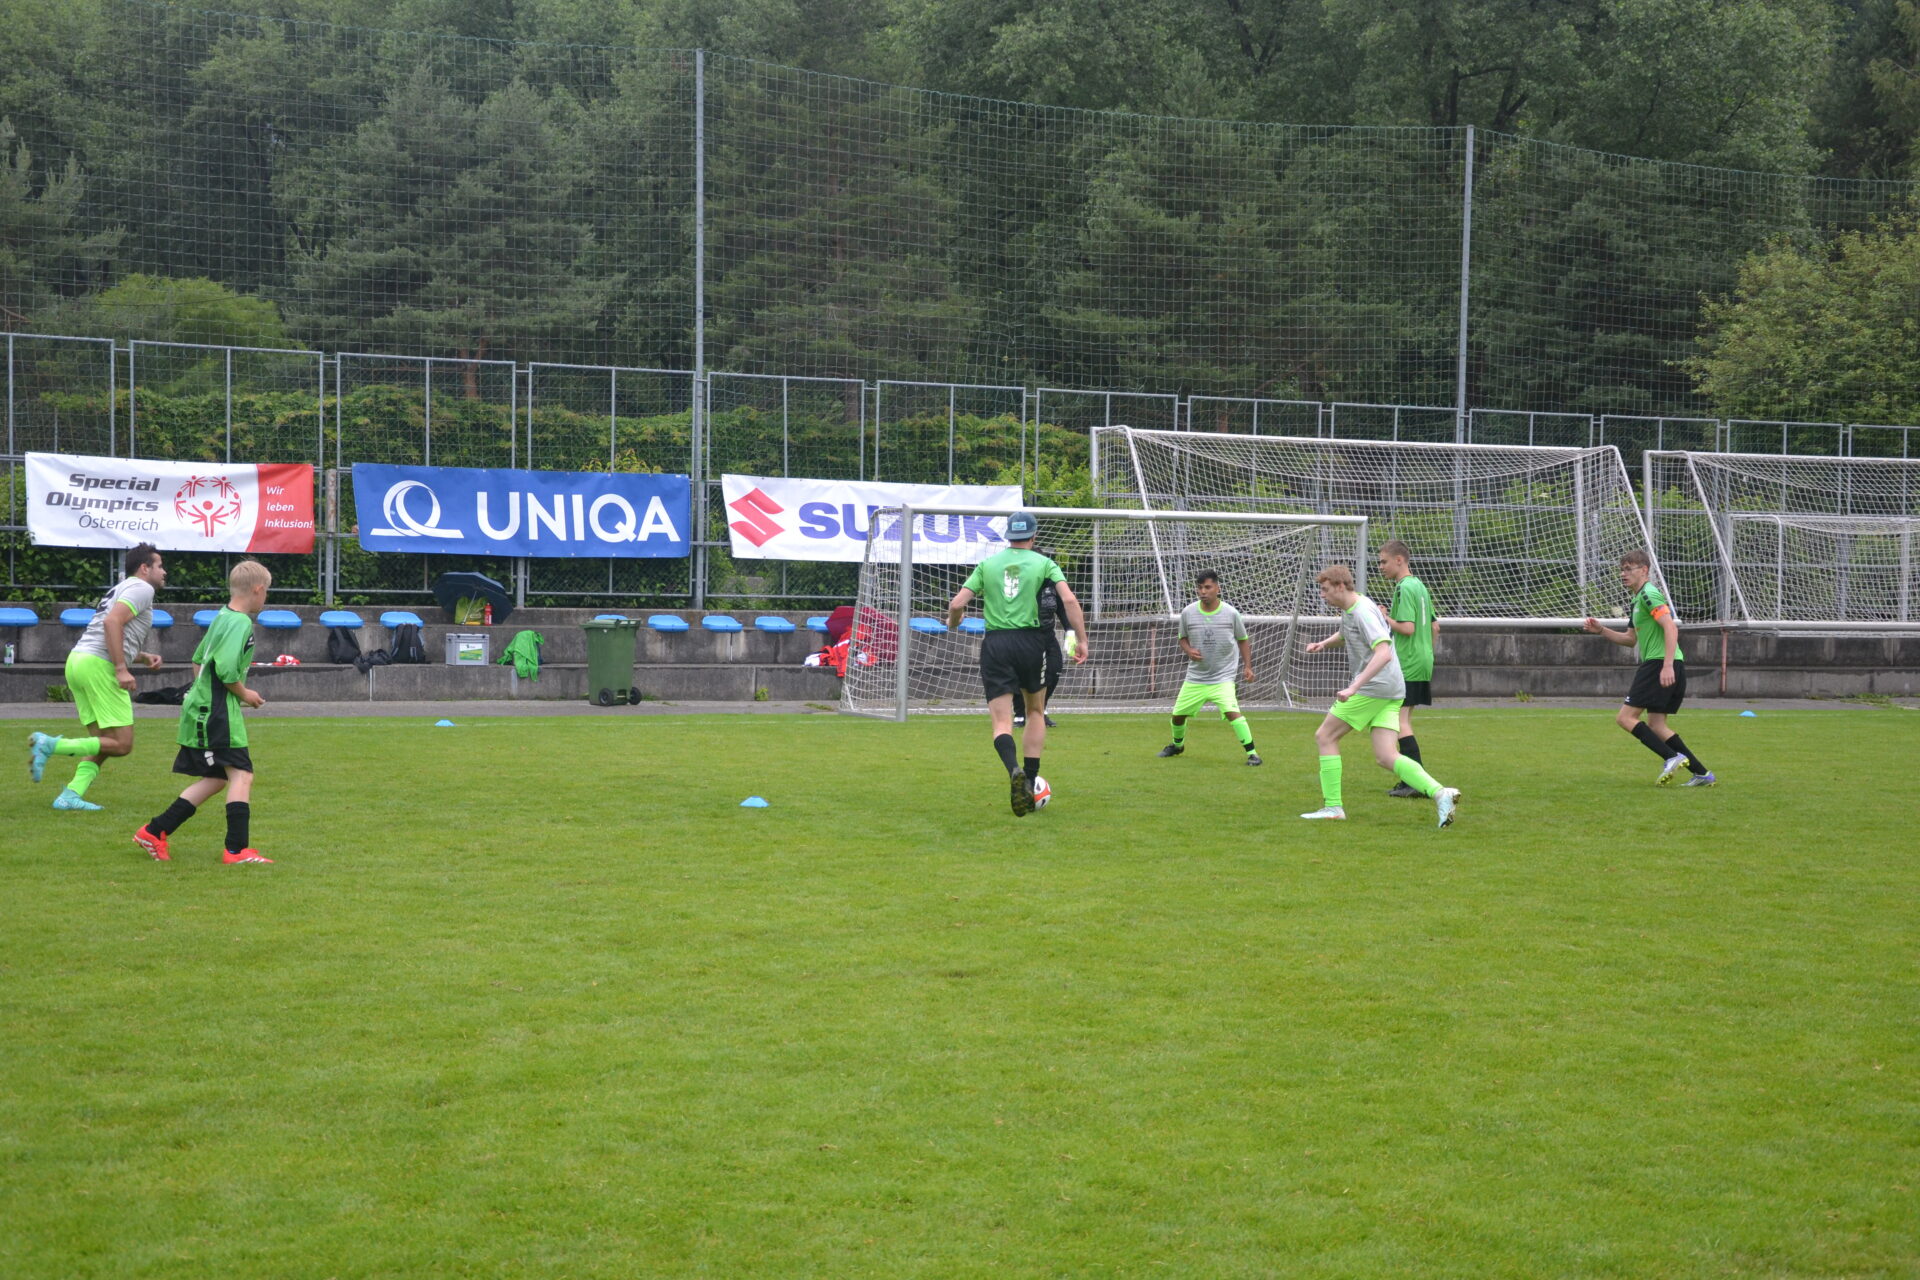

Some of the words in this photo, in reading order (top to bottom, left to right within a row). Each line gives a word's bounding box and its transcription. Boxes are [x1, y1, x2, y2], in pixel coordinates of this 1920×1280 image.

[68, 473, 160, 491] Special
[266, 486, 285, 495] Wir
[45, 491, 159, 513] Olympics
[266, 502, 295, 511] leben
[78, 511, 159, 531] Österreich
[264, 518, 313, 528] Inklusion!
[476, 491, 681, 543] UNIQA
[798, 501, 1005, 544] SUZUK
